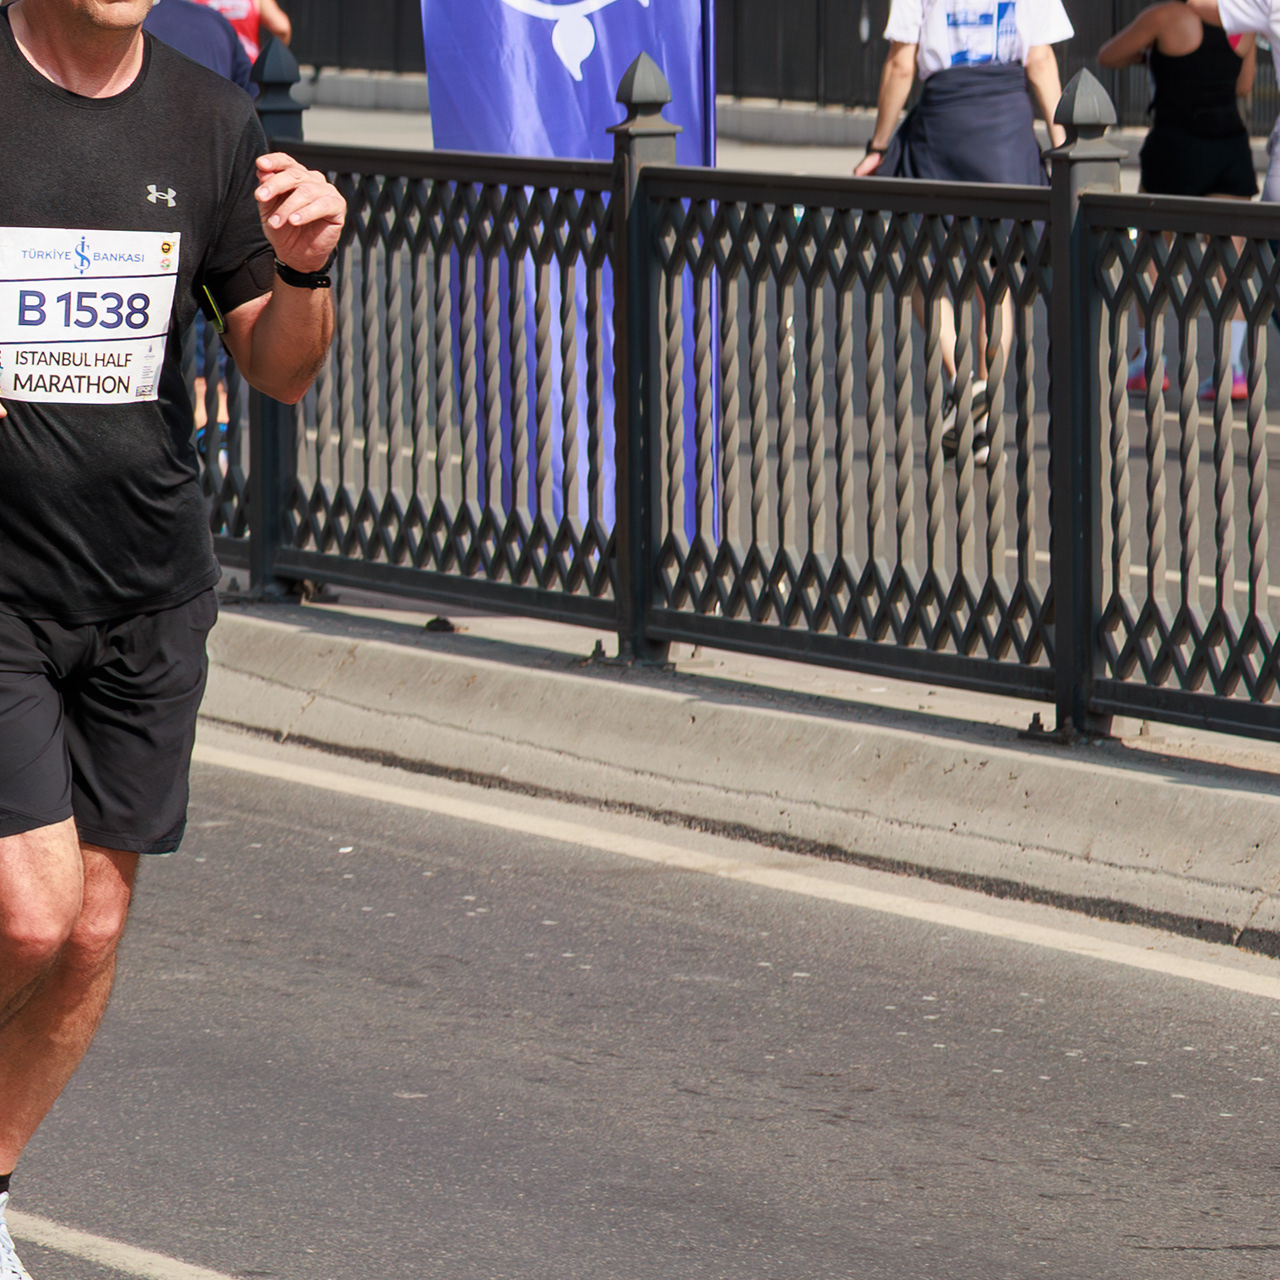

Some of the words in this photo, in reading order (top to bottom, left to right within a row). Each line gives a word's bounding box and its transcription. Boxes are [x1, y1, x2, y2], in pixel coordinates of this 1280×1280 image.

[21, 249, 71, 261] TÜRKİYE
[93, 252, 145, 263] BANKASI
[18, 290, 47, 326] B
[56, 291, 151, 330] 1538
[15, 350, 91, 367] ISTANBUL
[94, 353, 133, 368] HALF
[13, 373, 130, 395] MARATHON
